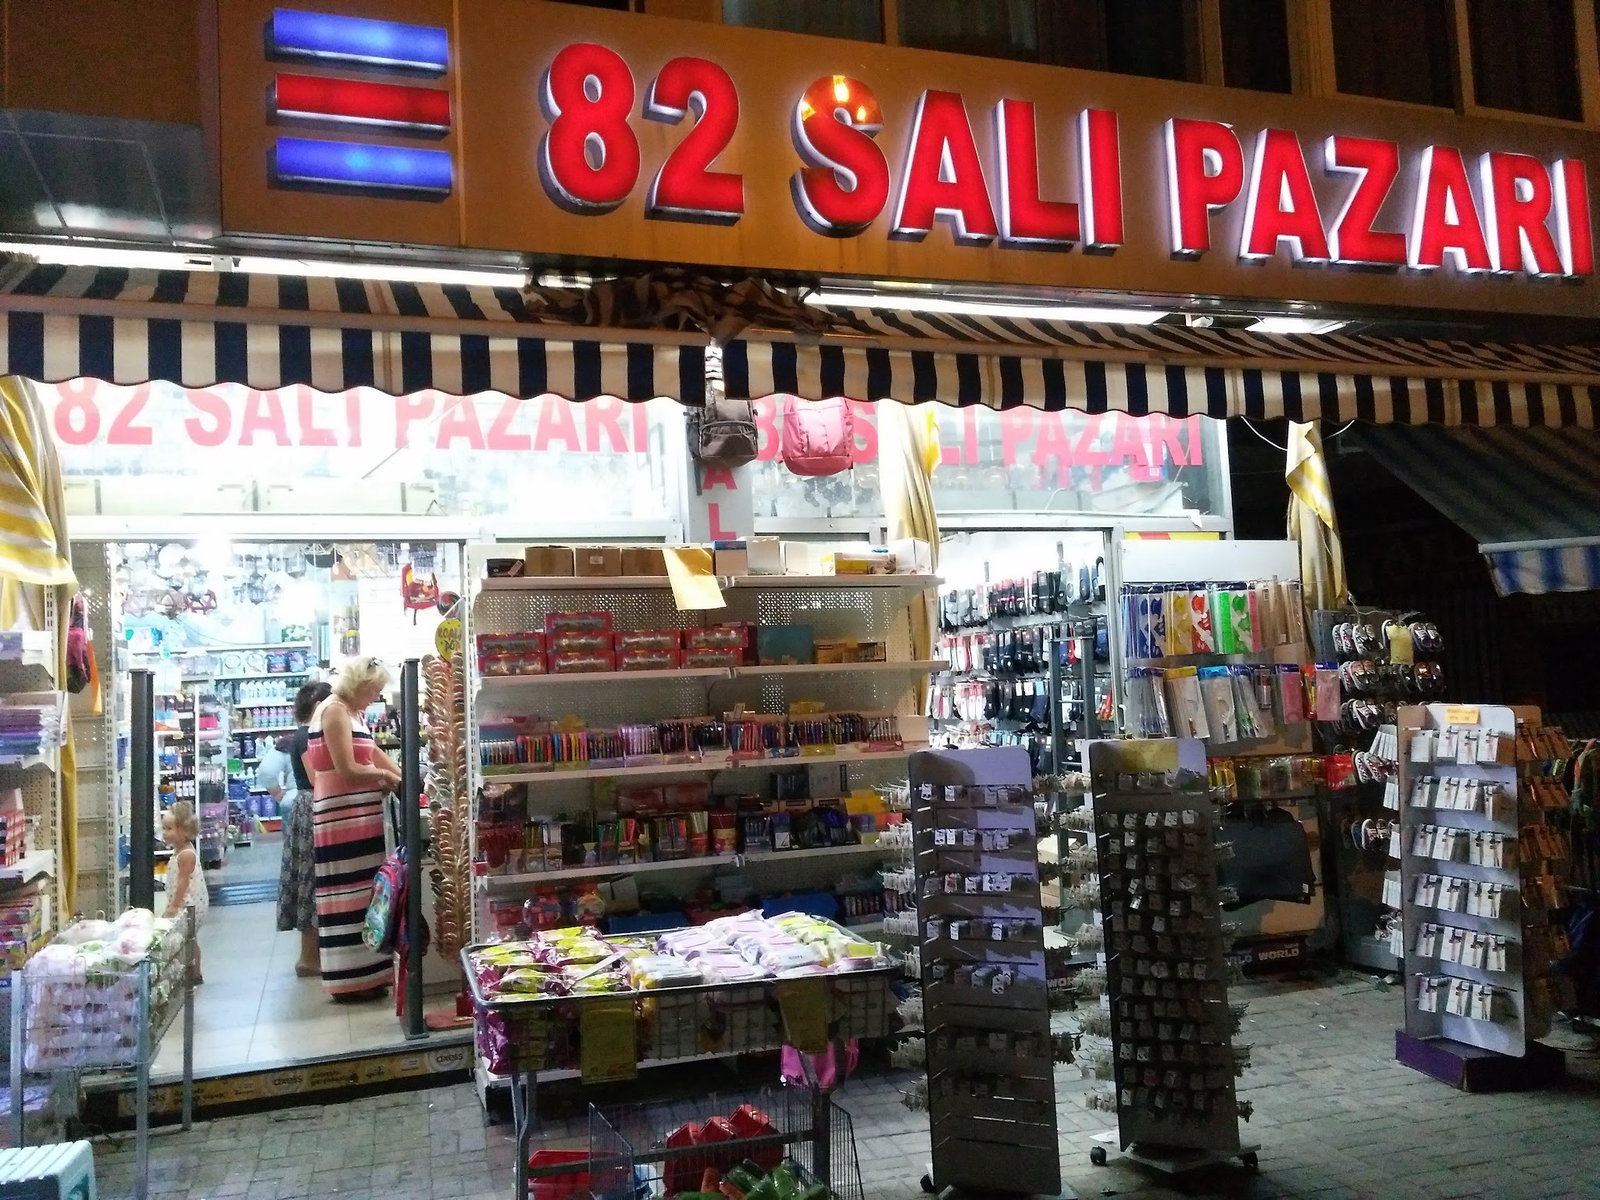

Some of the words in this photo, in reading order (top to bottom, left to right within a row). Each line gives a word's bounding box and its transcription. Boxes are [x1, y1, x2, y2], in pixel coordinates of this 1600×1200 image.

[541, 43, 743, 214] 82
[793, 74, 1123, 248] SALI
[1165, 116, 1594, 278] PAZARI
[54, 377, 153, 446] 82
[184, 380, 362, 447] SALI
[395, 388, 648, 453] PAZARI
[1258, 947, 1299, 961] WORLD
